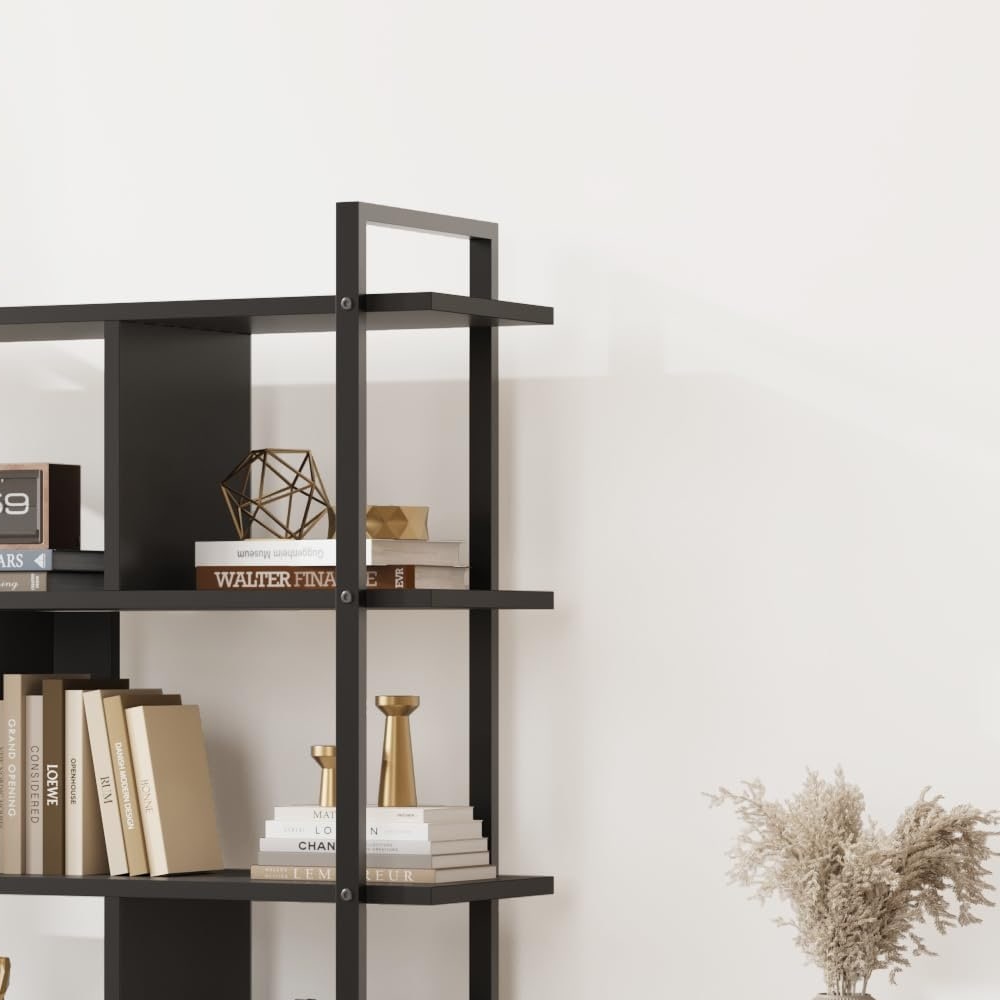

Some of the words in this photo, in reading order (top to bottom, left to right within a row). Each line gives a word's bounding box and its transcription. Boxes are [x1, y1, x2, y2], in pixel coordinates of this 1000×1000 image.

[237, 550, 271, 559] Museum
[213, 571, 292, 588] WALTER
[293, 570, 378, 588] FINAE
[7, 718, 17, 760] GRAND
[114, 742, 126, 770] DANISH
[7, 763, 17, 817] OPENING
[30, 745, 40, 824] CONSIDERED
[46, 764, 58, 806] LOEWE
[100, 775, 113, 804] RUM
[119, 770, 131, 803] MODERN
[123, 802, 135, 830] DESIGN
[298, 841, 336, 851] CHAN
